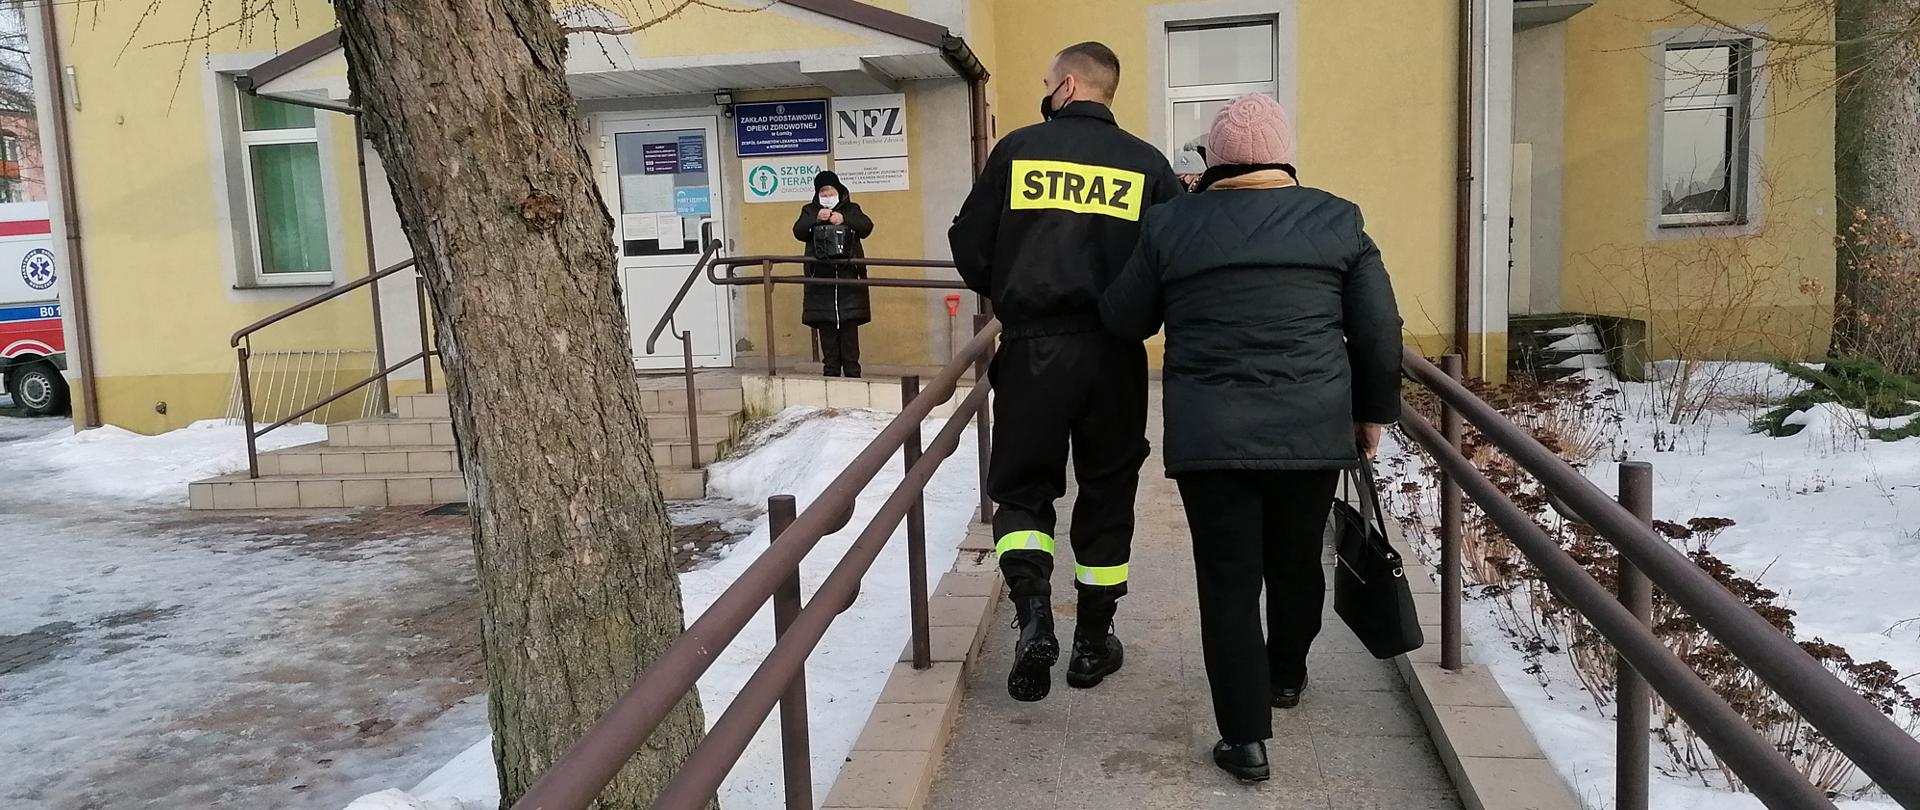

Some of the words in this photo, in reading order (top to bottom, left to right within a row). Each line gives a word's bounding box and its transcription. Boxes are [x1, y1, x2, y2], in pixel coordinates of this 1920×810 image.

[741, 116, 768, 124] ZAKŁAD
[769, 113, 822, 122] PODSTAWOWEJ
[836, 108, 903, 138] NFZ
[746, 124, 769, 132] OPIEKI
[770, 122, 817, 131] ZDROWOTNEJ
[781, 165, 821, 176] SZYBKA
[781, 176, 816, 186] TERAP
